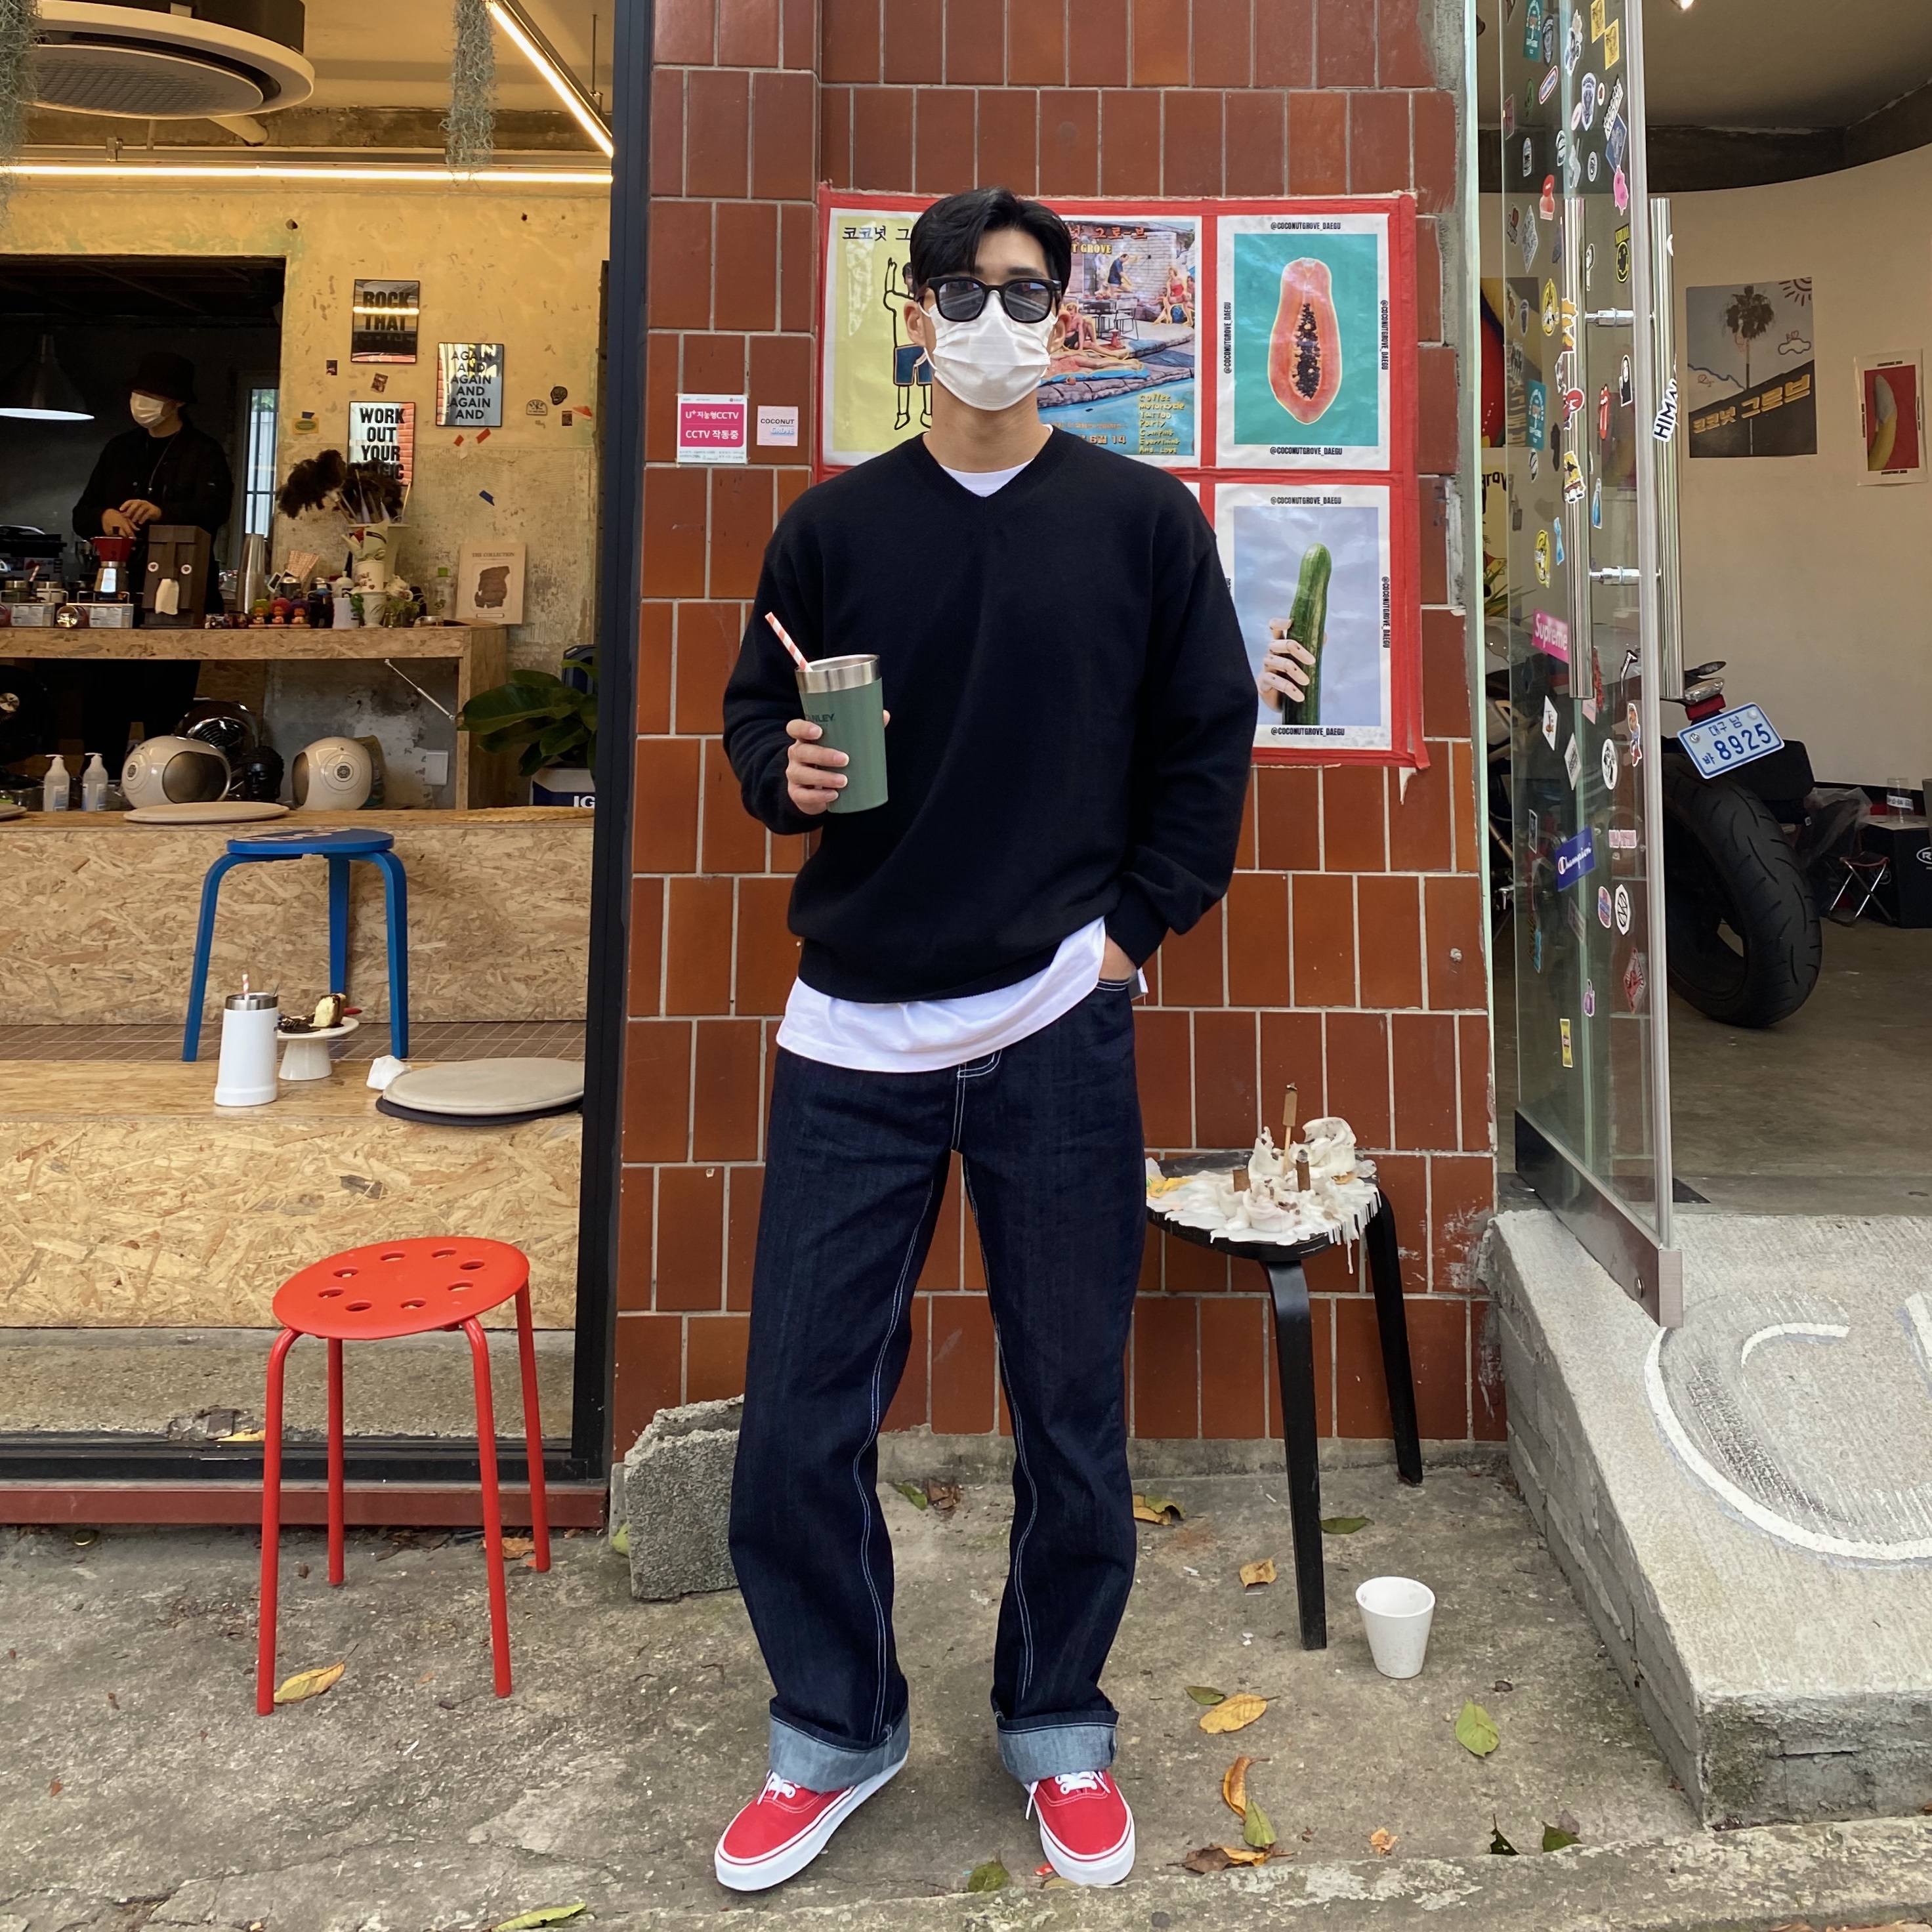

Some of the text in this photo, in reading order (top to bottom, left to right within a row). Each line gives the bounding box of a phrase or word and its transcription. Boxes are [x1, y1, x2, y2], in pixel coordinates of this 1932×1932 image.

[842, 225, 887, 242] 코코넛
[1080, 243, 1112, 254] GROVE
[362, 291, 411, 308] ROCK
[363, 313, 408, 331] THAT
[451, 350, 492, 361] AGAIN
[457, 362, 485, 373] AND
[450, 375, 491, 385] AGAIN
[456, 386, 485, 396] AND
[449, 398, 491, 408] AGAIN
[1693, 374, 1811, 434] 코코넛 그로브
[359, 408, 406, 423] WORK
[455, 410, 484, 419] AND
[367, 427, 397, 442] OUT
[685, 429, 739, 440] CCTV 작동중
[361, 445, 400, 461] YOUR
[1535, 613, 1568, 651] Supreme
[1708, 715, 1743, 736] 대구 남
[1714, 723, 1771, 761] 8925
[1558, 847, 1592, 875] Champion
